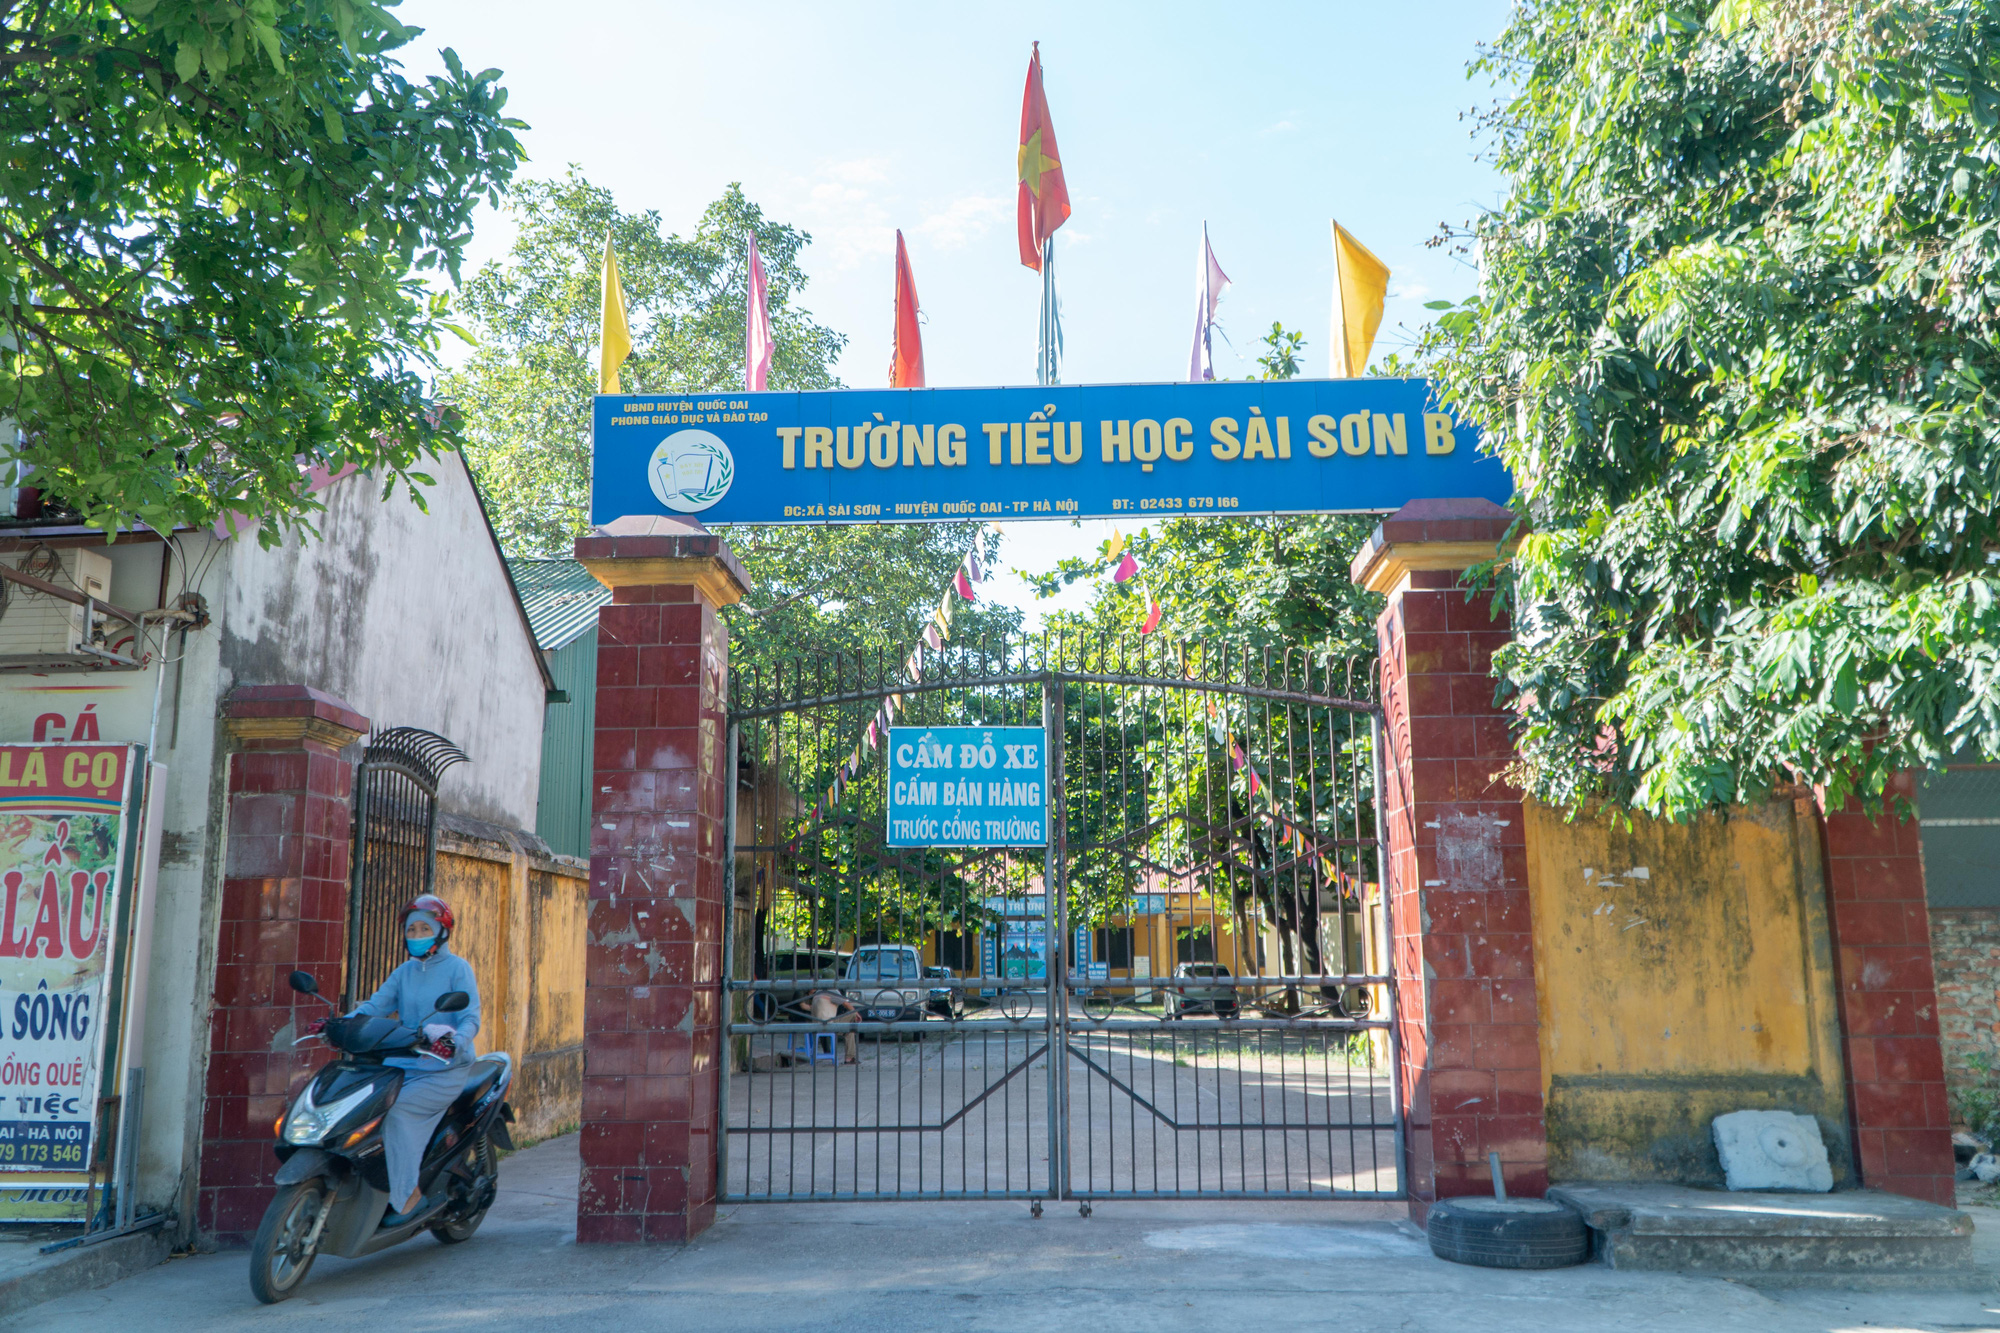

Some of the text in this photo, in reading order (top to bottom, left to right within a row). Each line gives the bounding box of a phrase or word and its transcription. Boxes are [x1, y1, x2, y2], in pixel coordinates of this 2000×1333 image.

[623, 399, 749, 413] UBND HUYỆN QUỐC OAI
[651, 413, 679, 425] GIÁO
[681, 414, 704, 426] DỤC
[706, 411, 721, 423] VÀ
[722, 411, 746, 423] ĐÀO
[748, 412, 769, 424] TẠO
[776, 403, 1457, 473] TRƯỜNG TIỂU HỌC SÀI SƠN B
[828, 503, 850, 516] SÀI
[853, 504, 881, 516] SƠN
[895, 501, 938, 517] HUYỆN
[942, 500, 976, 514] QUỐC
[980, 502, 1002, 513] OAI
[1012, 501, 1029, 512] TP
[1033, 499, 1051, 512] HÀ
[1055, 498, 1079, 514] NỘI
[1112, 499, 1134, 510] ĐT:
[1140, 497, 1182, 510] 02433
[1188, 497, 1213, 508] 679
[896, 731, 1039, 769] CẤM ĐỖ XE
[0, 747, 118, 796] LÁ CỌ
[894, 773, 1040, 807] CẤM BÁN HÀNG
[893, 808, 1040, 841] TRƯỚC CỔNG TRƯỜNG
[12, 978, 90, 1042] SÔNG
[0, 1051, 83, 1086] ỒNG QUÊ
[16, 1092, 79, 1120] TIỆC
[28, 1125, 50, 1140] HÀ
[55, 1125, 83, 1144] NỘI
[21, 1144, 48, 1162] 173
[52, 1144, 82, 1162] 546
